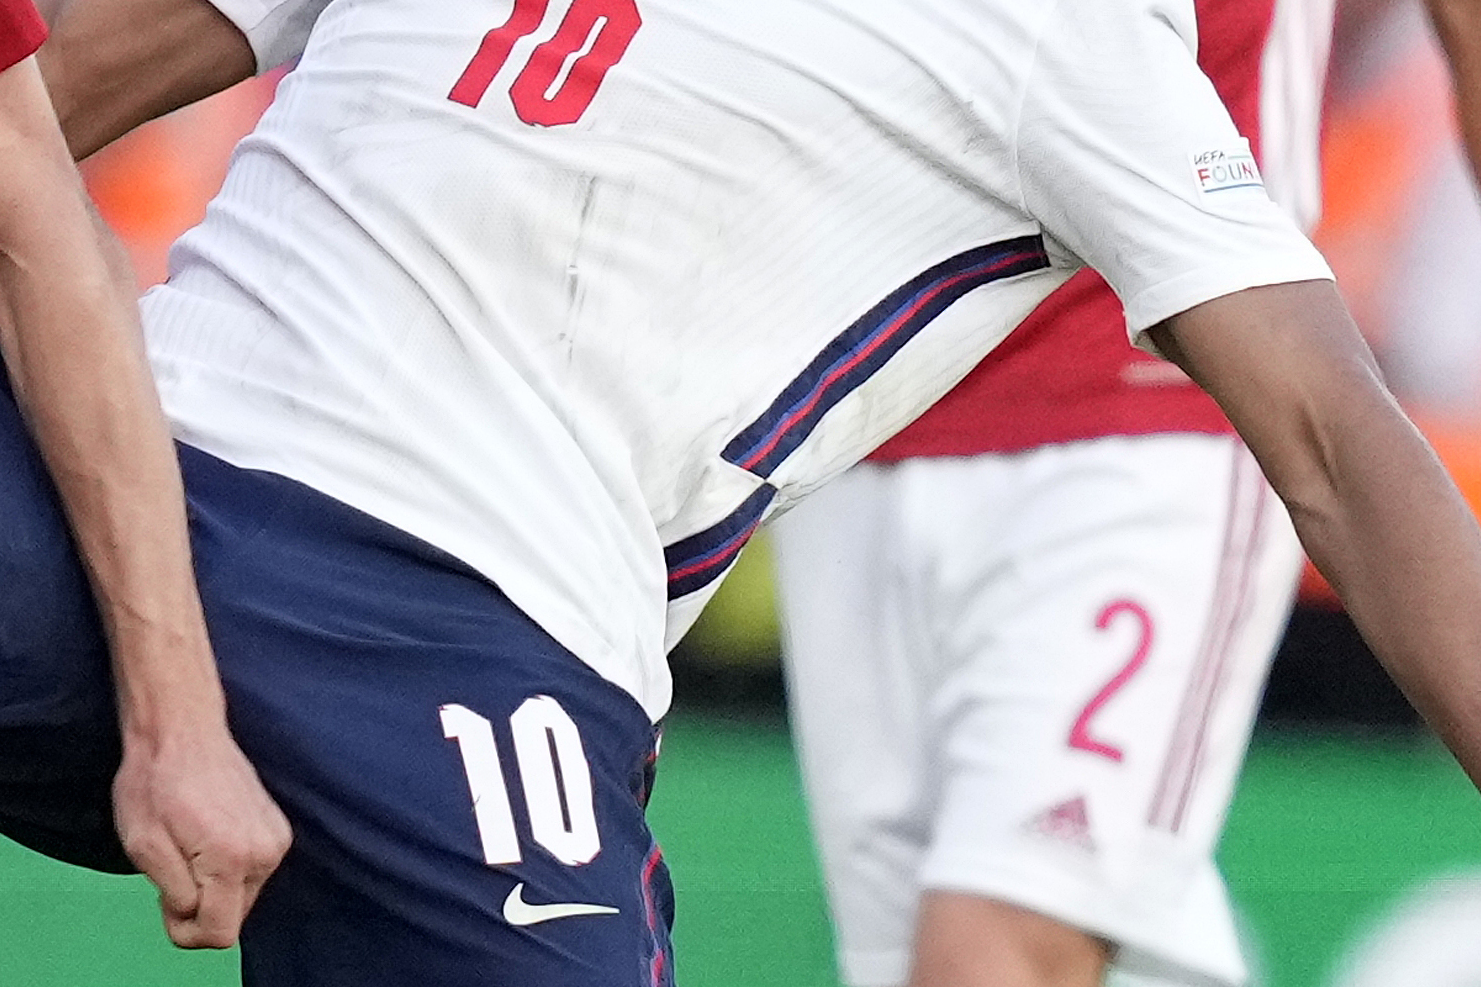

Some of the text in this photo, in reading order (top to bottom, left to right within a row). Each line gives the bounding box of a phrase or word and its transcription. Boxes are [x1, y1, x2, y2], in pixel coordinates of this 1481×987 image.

[1193, 149, 1225, 166] UEFA
[1068, 597, 1155, 764] 2
[439, 694, 601, 866] 10
